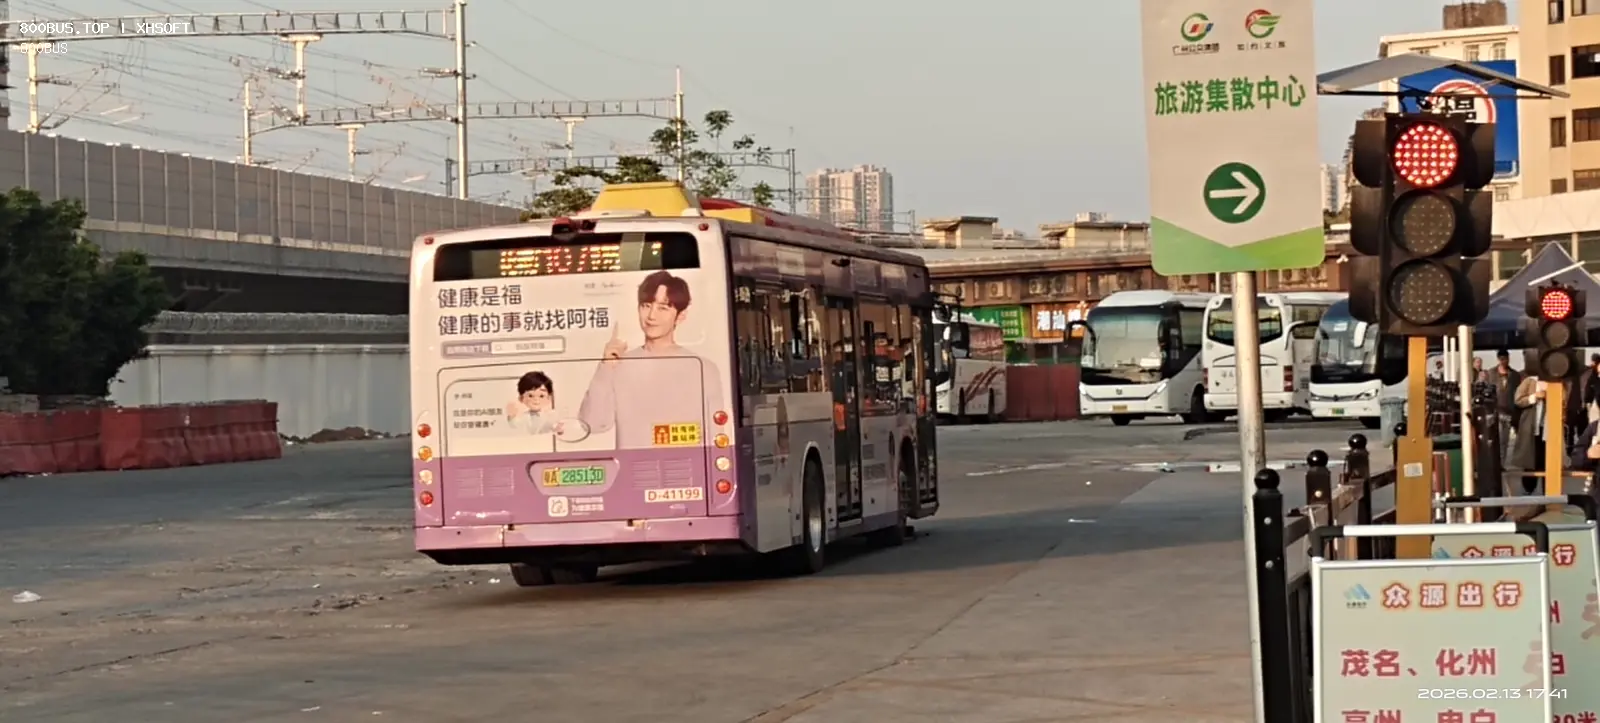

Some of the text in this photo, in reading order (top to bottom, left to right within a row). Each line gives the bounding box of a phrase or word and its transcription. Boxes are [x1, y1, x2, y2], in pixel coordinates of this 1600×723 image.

[1154, 74, 1306, 116] 旅游集散中心
[437, 284, 522, 309] 健康是福
[437, 307, 610, 336] 健康的事就找阿福
[647, 488, 701, 501] D-41199
[1382, 582, 1521, 609] 众源出行
[1340, 648, 1497, 678] 茂名、化州
